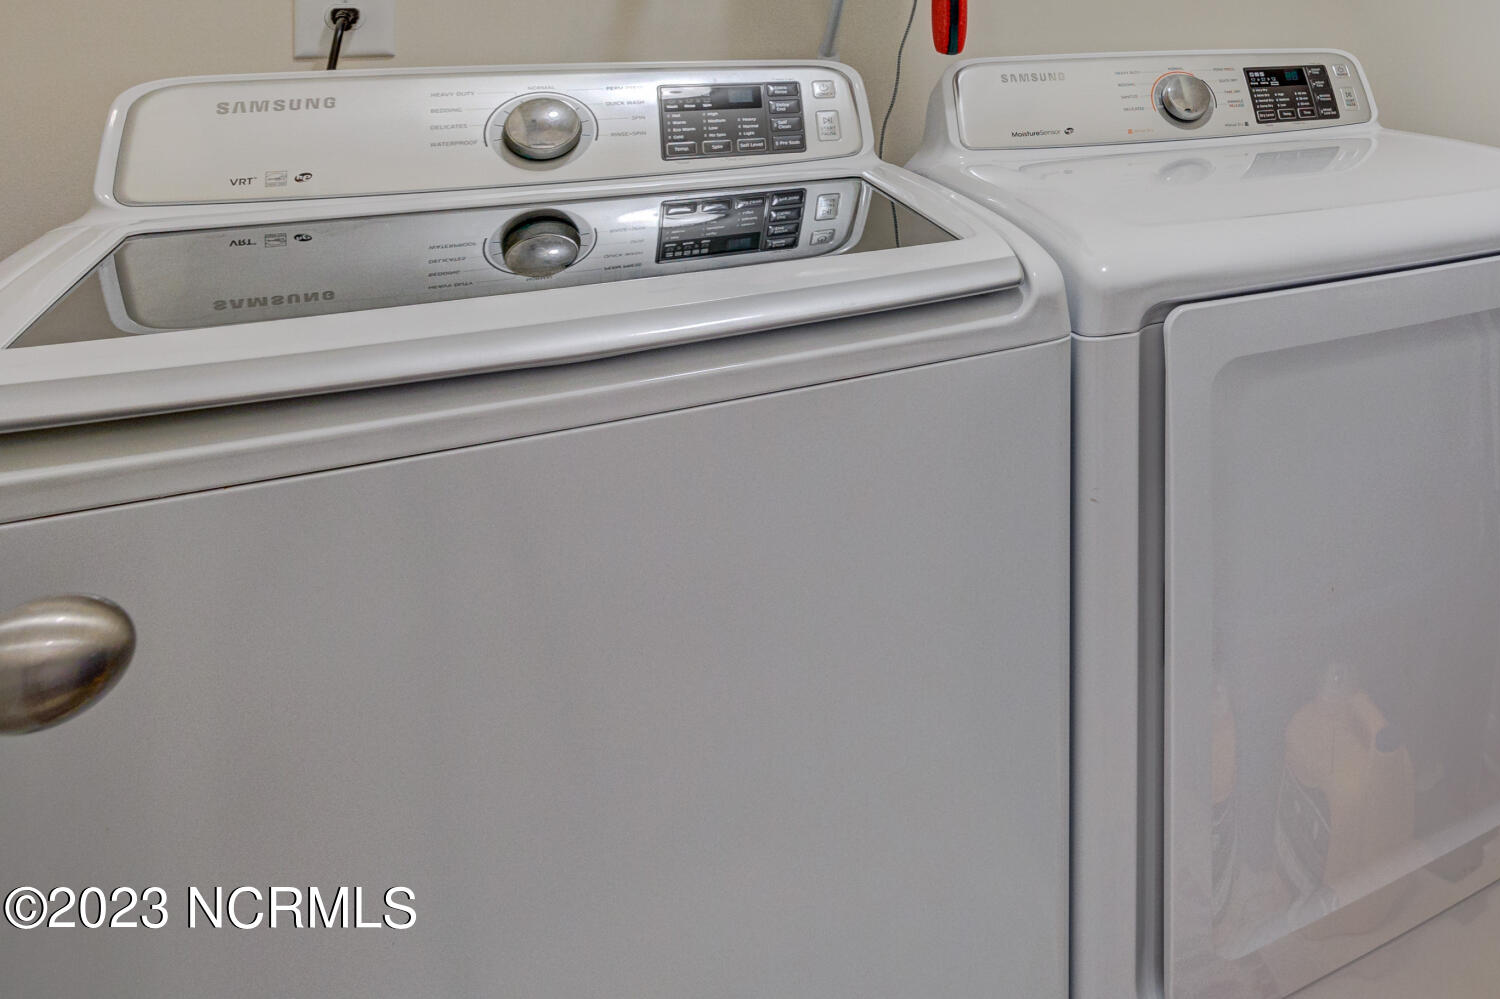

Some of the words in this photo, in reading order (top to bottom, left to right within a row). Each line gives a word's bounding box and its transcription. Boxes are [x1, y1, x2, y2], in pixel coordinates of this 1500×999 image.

[1000, 72, 1065, 84] SAMSUNG
[215, 96, 337, 116] SAMSUNG
[429, 140, 479, 148] WATERPROOF
